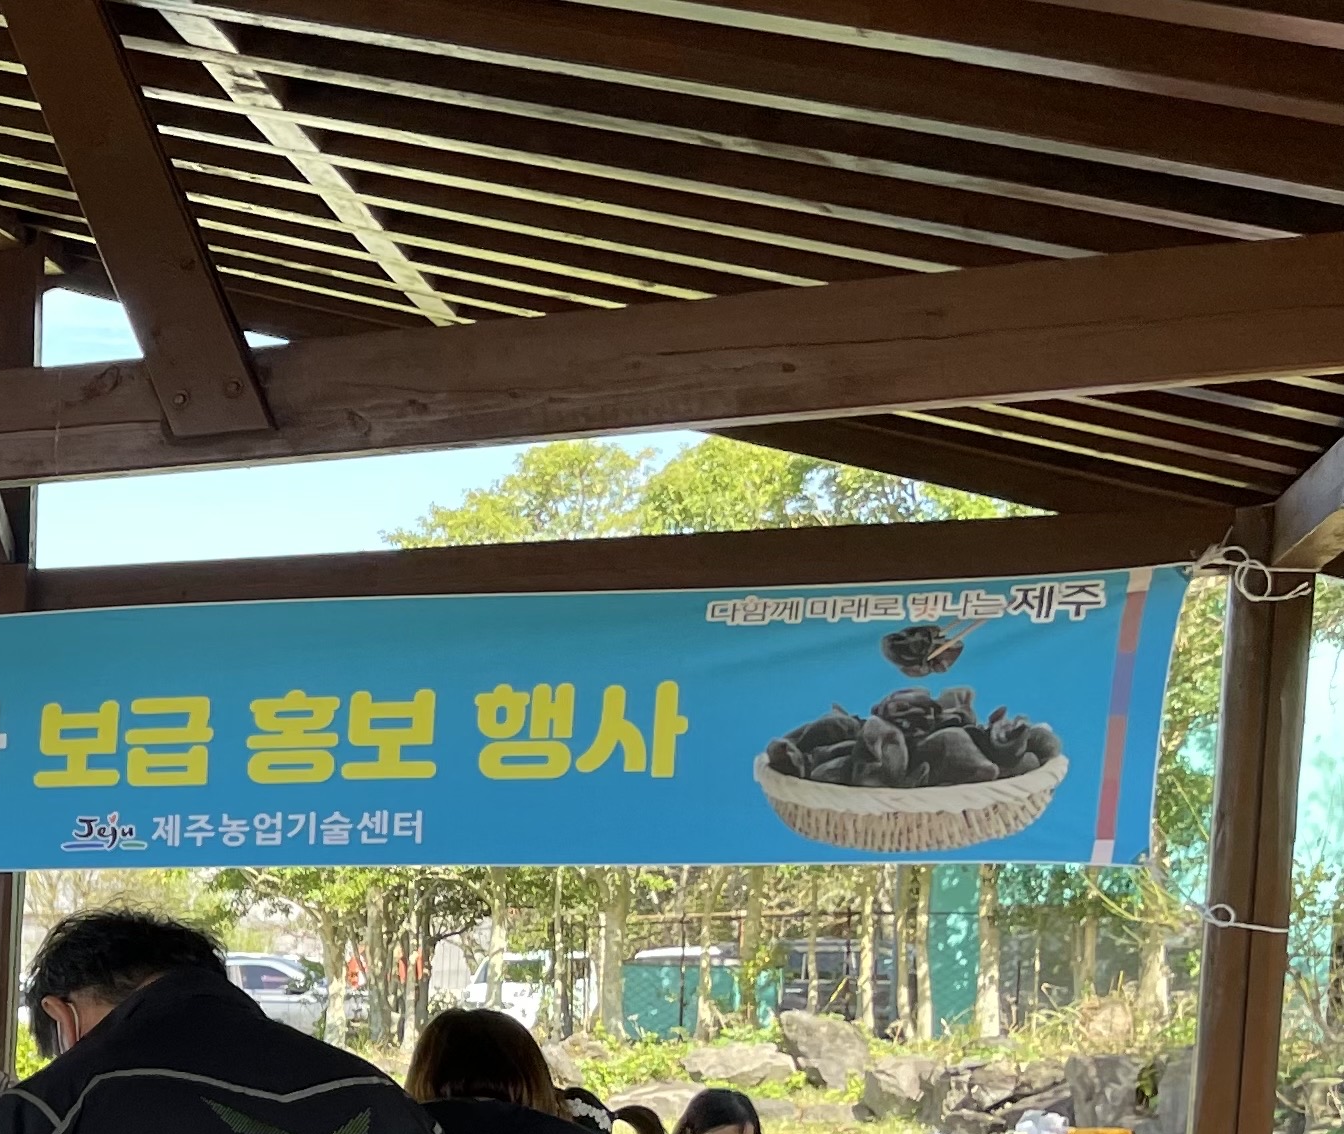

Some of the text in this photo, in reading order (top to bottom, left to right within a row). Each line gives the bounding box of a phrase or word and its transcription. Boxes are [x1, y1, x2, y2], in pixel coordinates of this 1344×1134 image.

[709, 581, 1104, 623] 다함께 미래로 빛나는 제주
[33, 696, 214, 789] 보급
[245, 689, 437, 784] 홍보
[474, 681, 688, 780] 행사
[74, 812, 137, 850] Jeju
[151, 809, 423, 848] 제주농업기술센터
